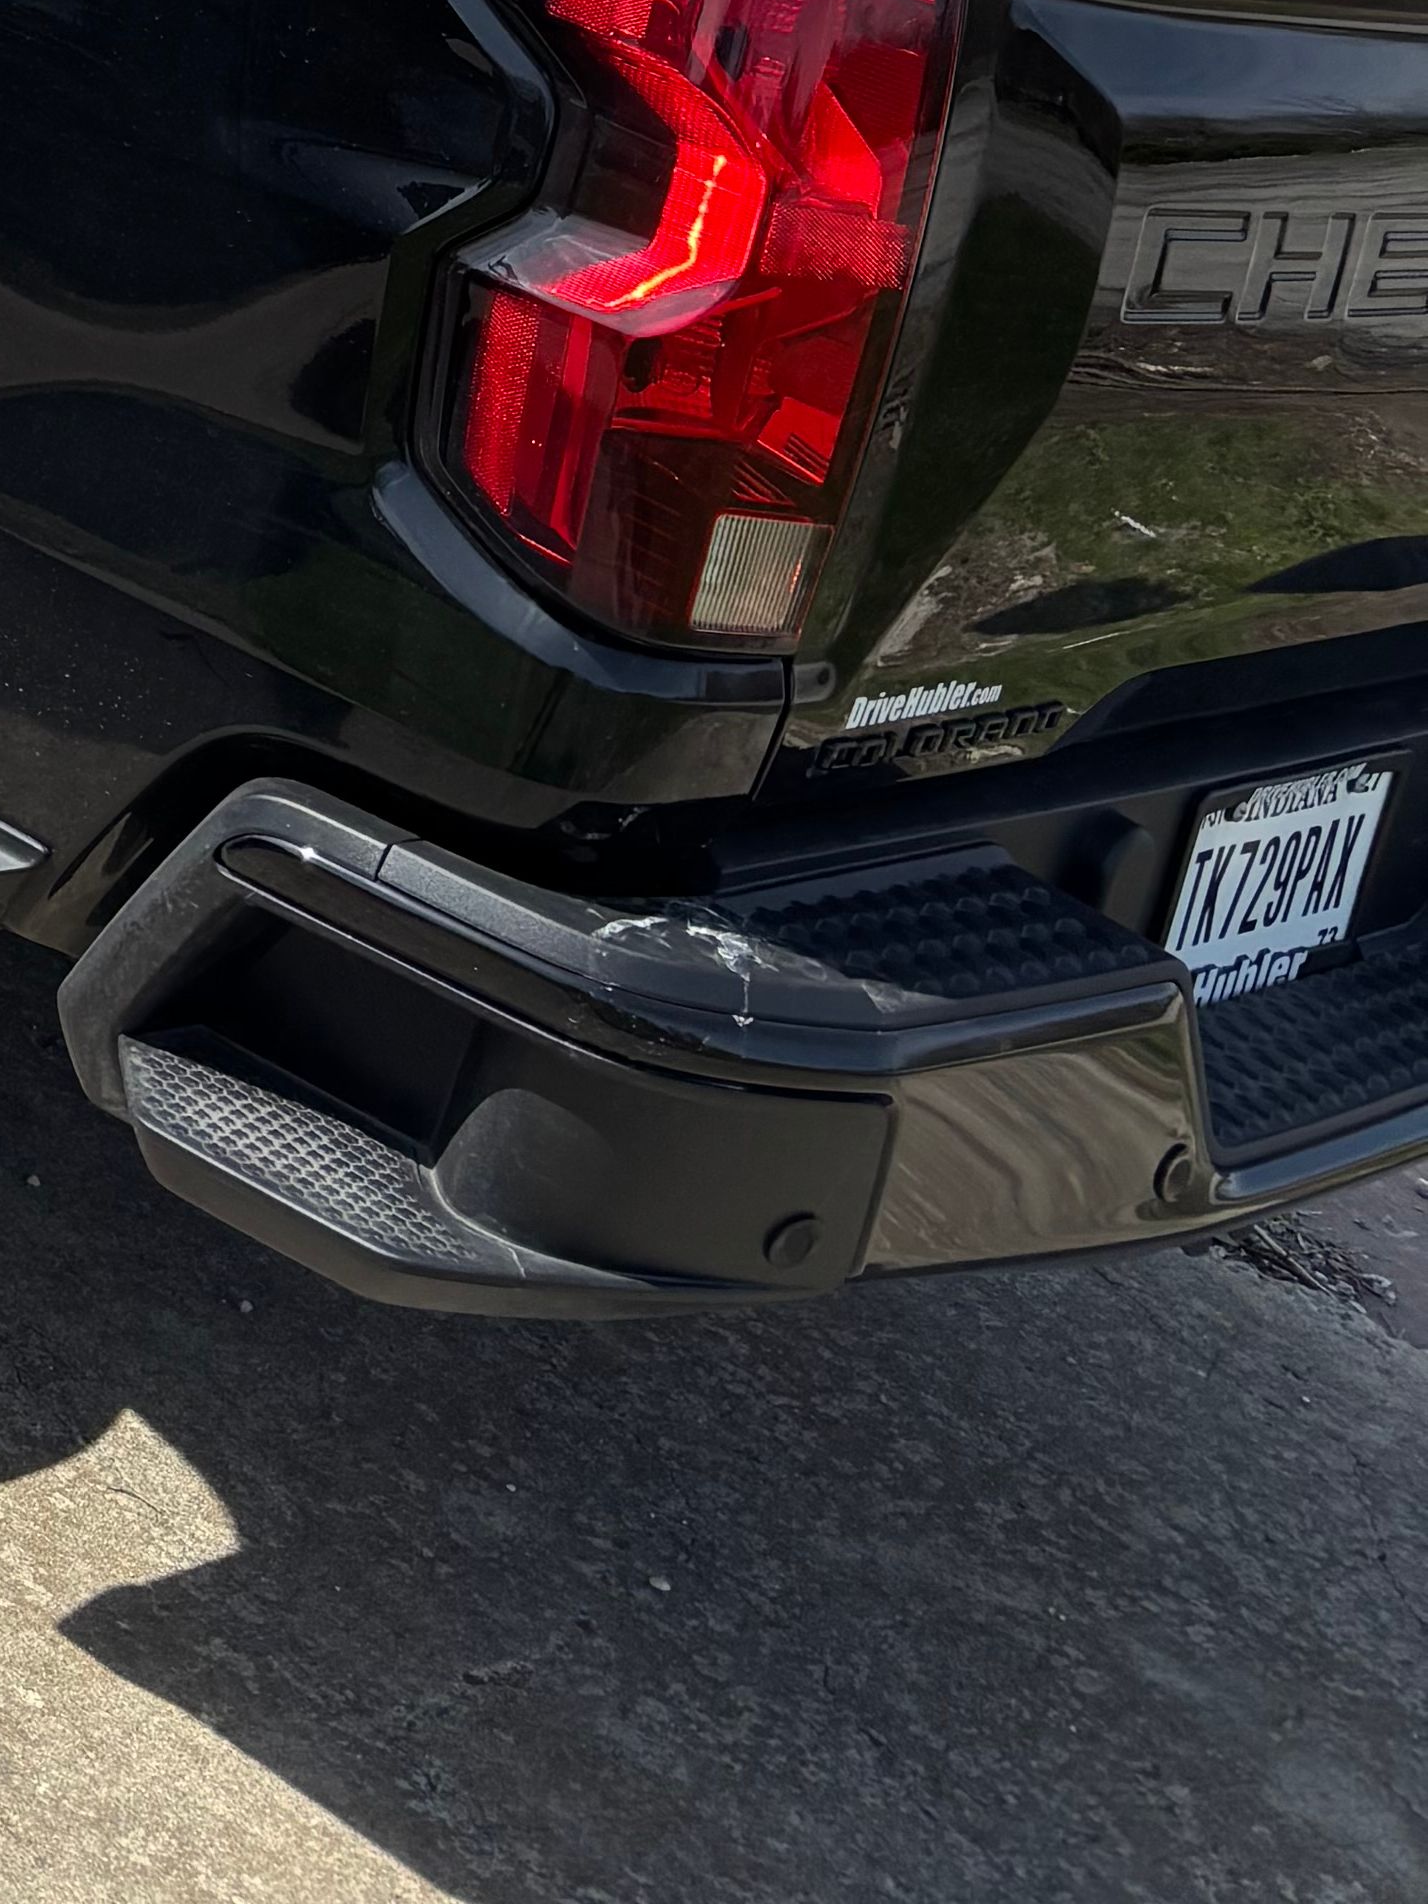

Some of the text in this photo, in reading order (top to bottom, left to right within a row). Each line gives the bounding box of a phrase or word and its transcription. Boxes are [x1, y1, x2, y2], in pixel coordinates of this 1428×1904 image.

[845, 680, 1003, 730] DriveHubler.com
[1175, 813, 1366, 951] TK729PAX
[1193, 949, 1309, 1008] Hubler
